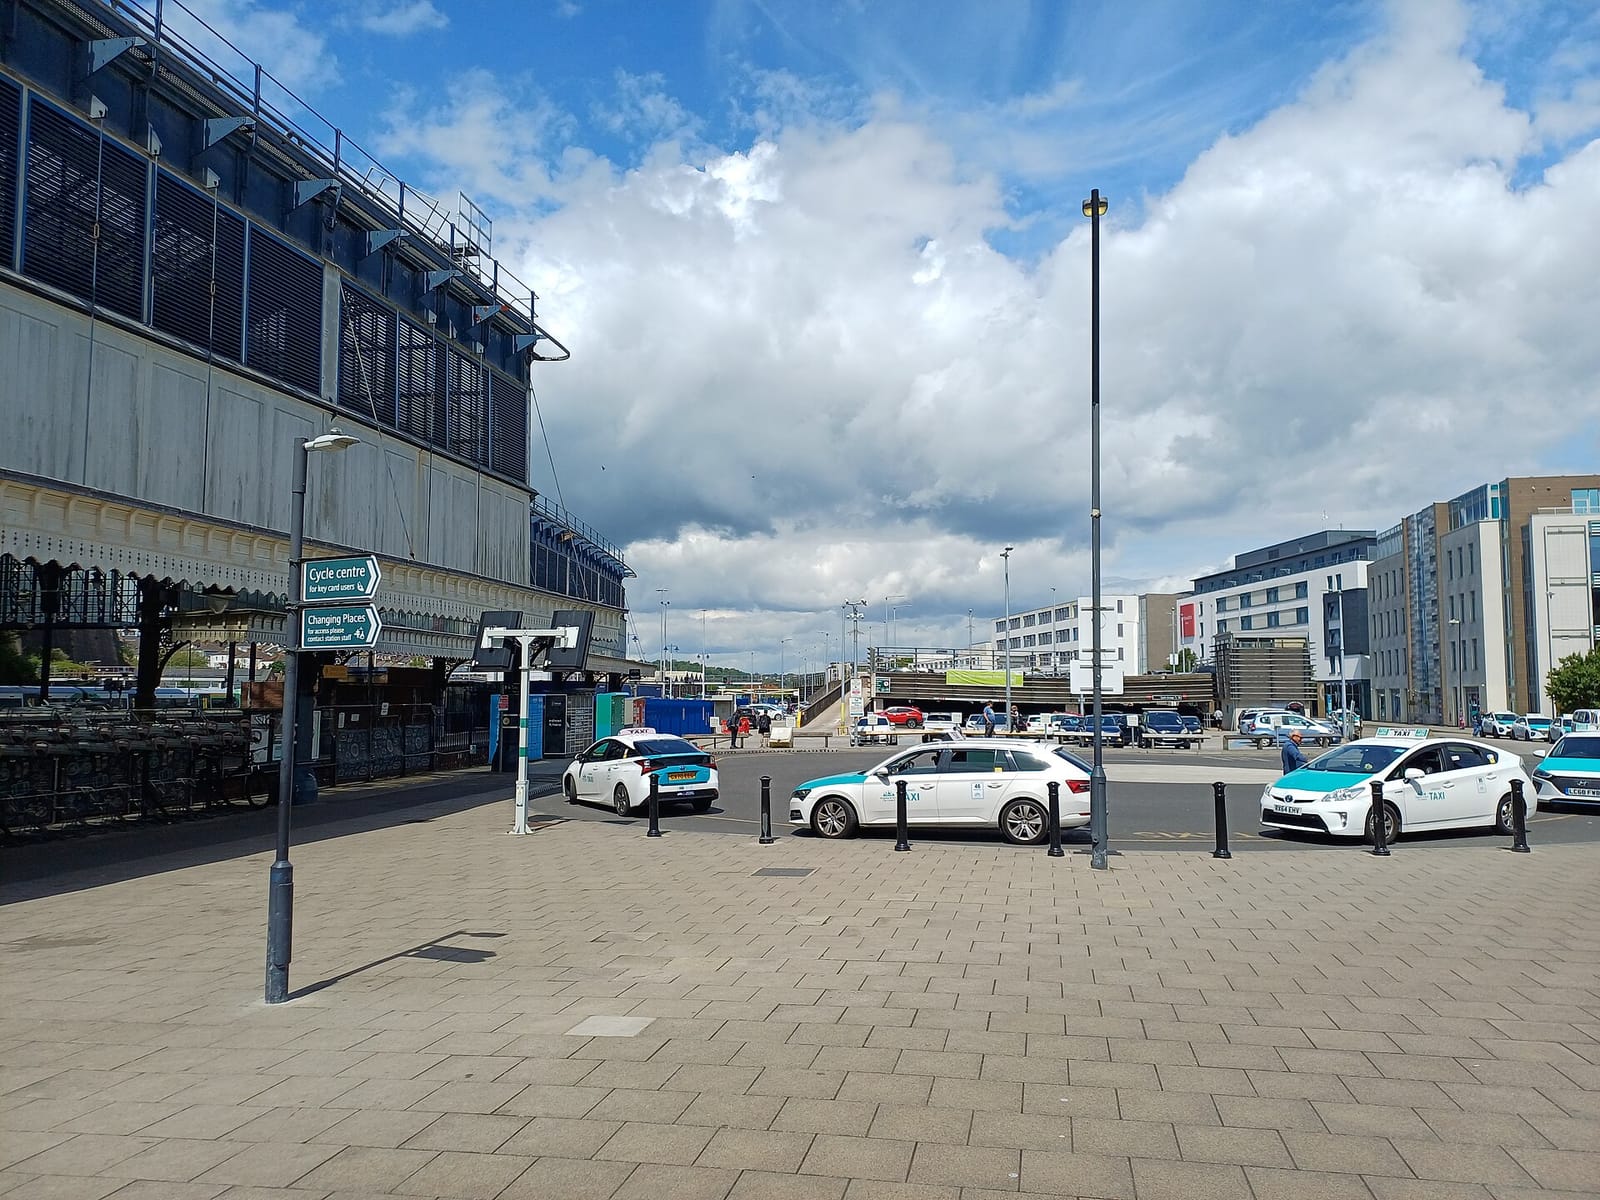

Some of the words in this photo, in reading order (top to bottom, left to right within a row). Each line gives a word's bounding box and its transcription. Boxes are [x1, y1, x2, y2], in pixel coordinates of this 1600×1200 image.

[309, 567, 334, 583] Cycle
[336, 566, 366, 579] centre
[309, 585, 317, 593] for
[317, 584, 327, 594] key
[328, 583, 340, 592] card
[308, 614, 341, 627] Changing
[342, 613, 366, 623] Places
[330, 627, 345, 635] please
[1429, 791, 1446, 801] TAXI
